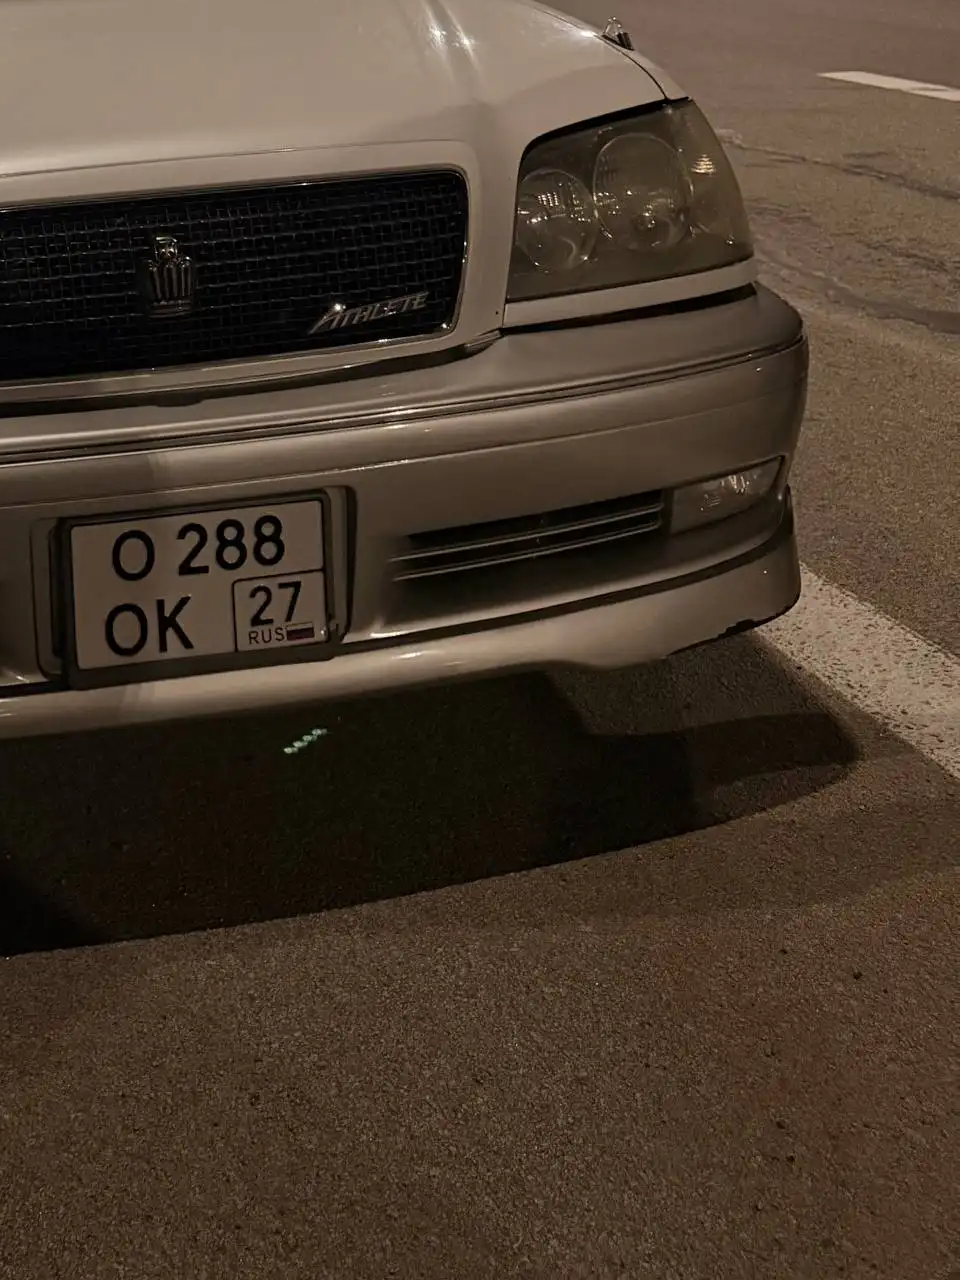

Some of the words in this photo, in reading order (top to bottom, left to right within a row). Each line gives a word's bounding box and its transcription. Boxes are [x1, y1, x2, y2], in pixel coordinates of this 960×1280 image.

[176, 515, 285, 576] 288
[105, 596, 194, 656] OK
[249, 581, 302, 627] 27
[248, 627, 287, 645] RUS
